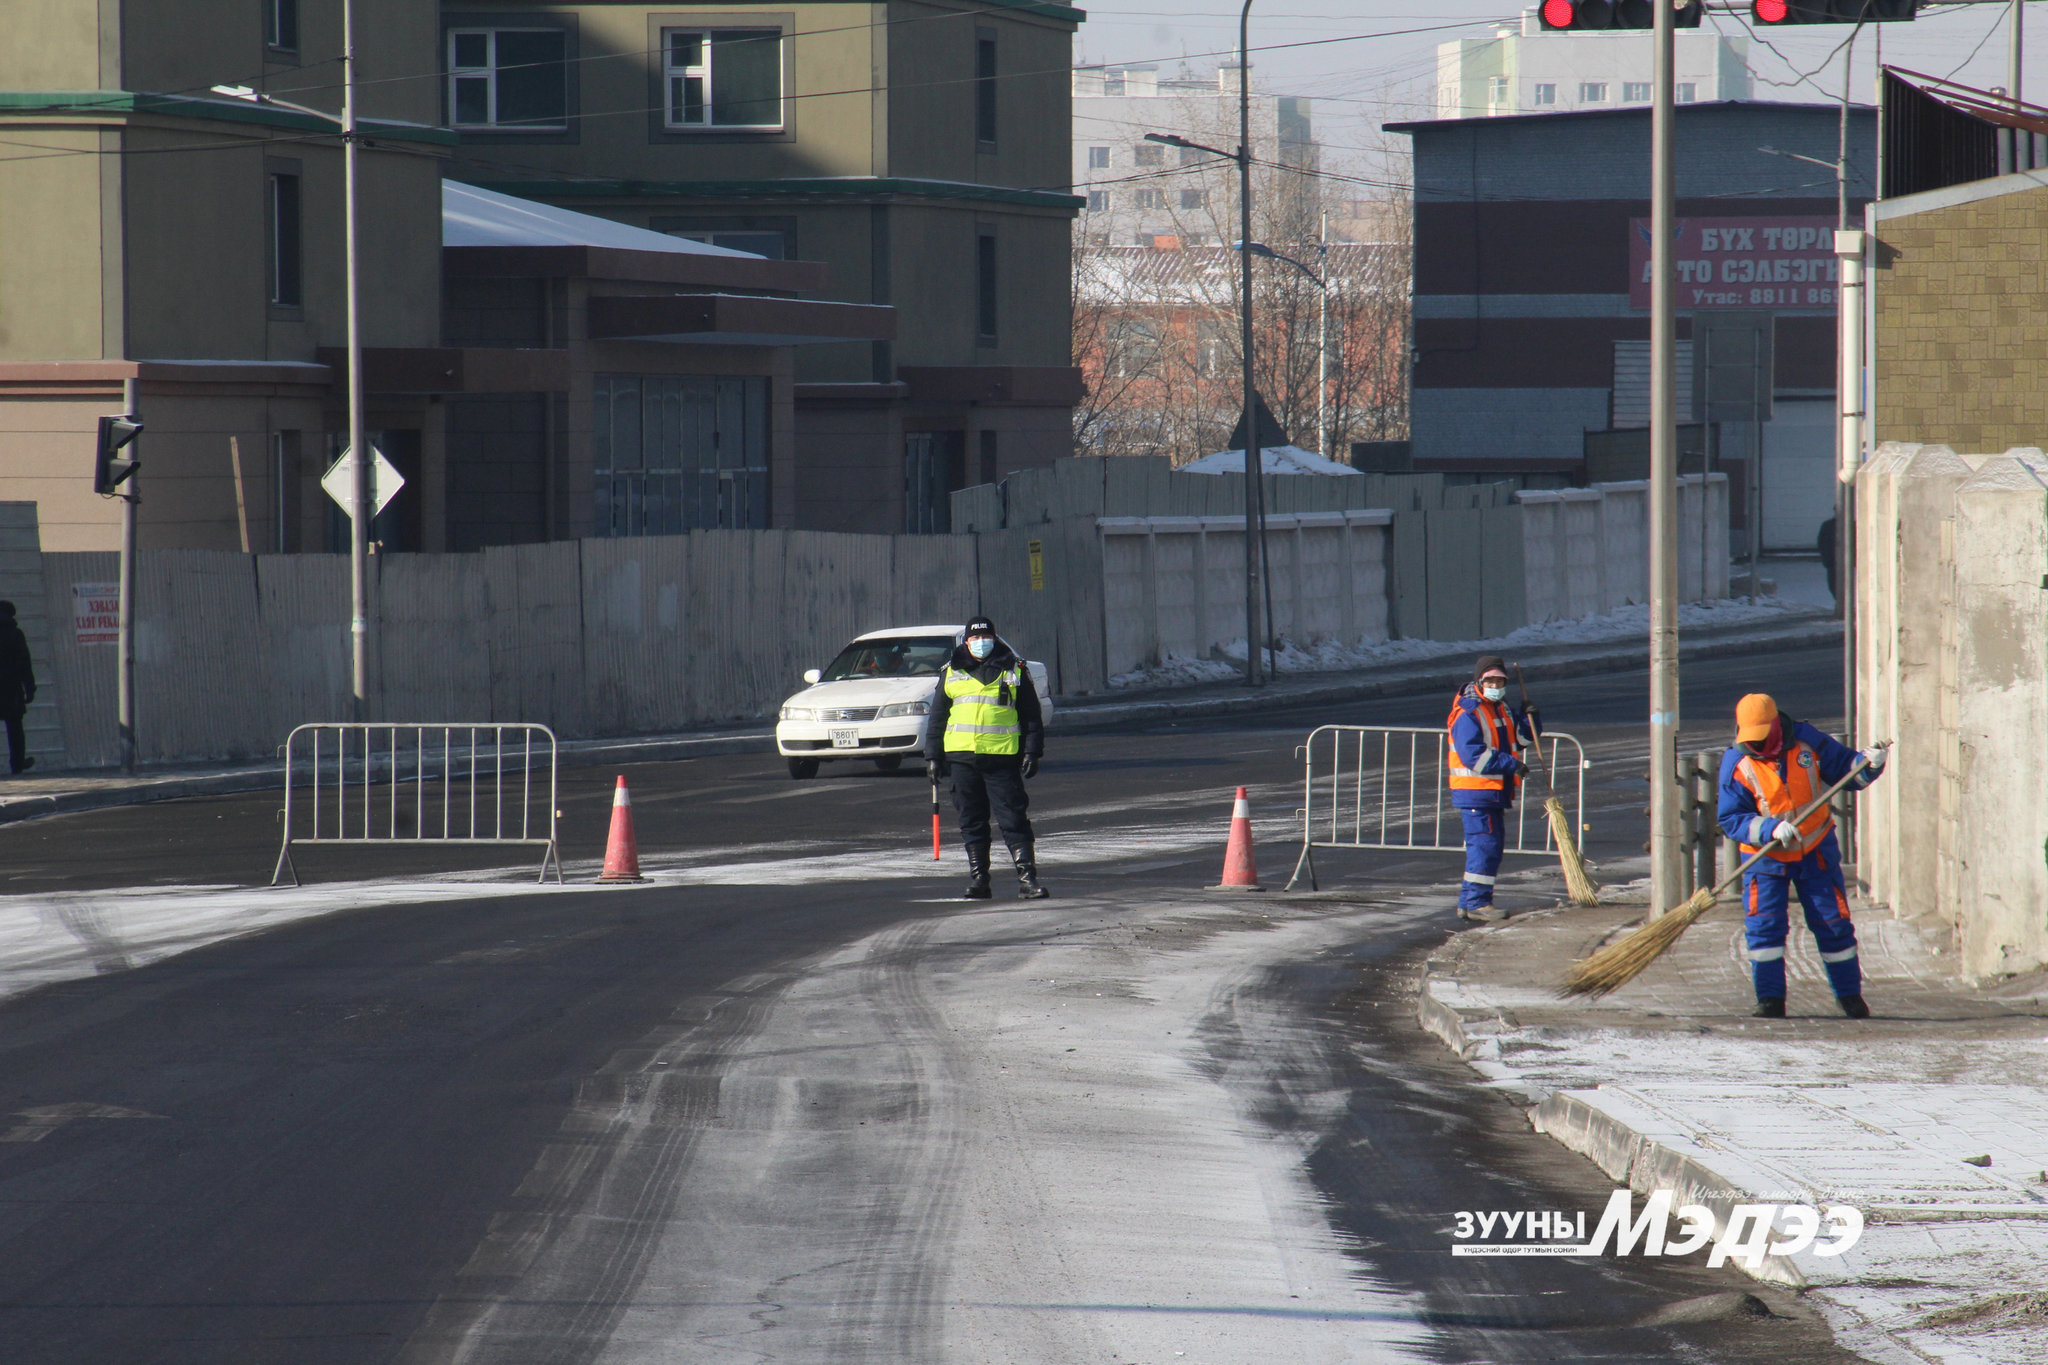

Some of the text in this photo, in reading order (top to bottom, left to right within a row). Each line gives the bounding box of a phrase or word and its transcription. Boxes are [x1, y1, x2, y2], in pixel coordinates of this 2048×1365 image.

[1702, 228, 1754, 250] БҮХ
[1642, 260, 1712, 283] АТО
[1693, 289, 1742, 304] Утас:
[1750, 288, 1798, 304] 8811
[970, 622, 988, 631] POLICE
[836, 731, 855, 739] 8801
